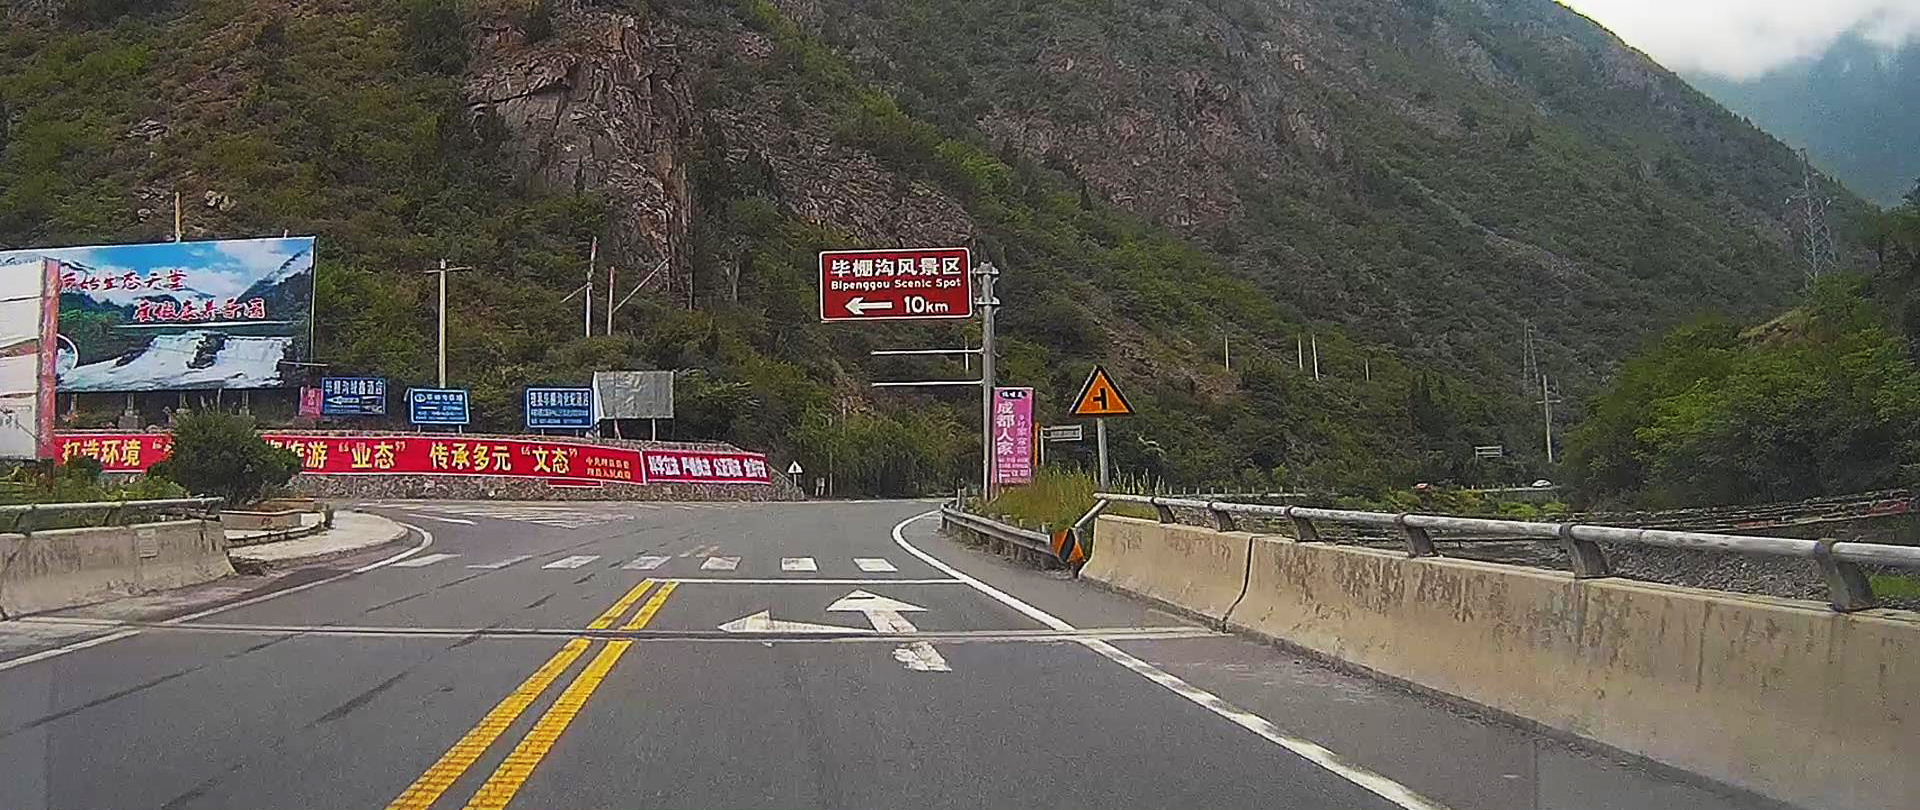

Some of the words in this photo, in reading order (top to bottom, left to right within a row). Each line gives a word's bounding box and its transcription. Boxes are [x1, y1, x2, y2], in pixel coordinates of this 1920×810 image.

[830, 257, 962, 278] 毕棚沟风景区
[831, 279, 890, 291] Bipenggou
[894, 278, 932, 289] Scenic
[935, 277, 962, 289] Spot
[904, 296, 949, 314] 10km
[996, 401, 1015, 456] 成都人家
